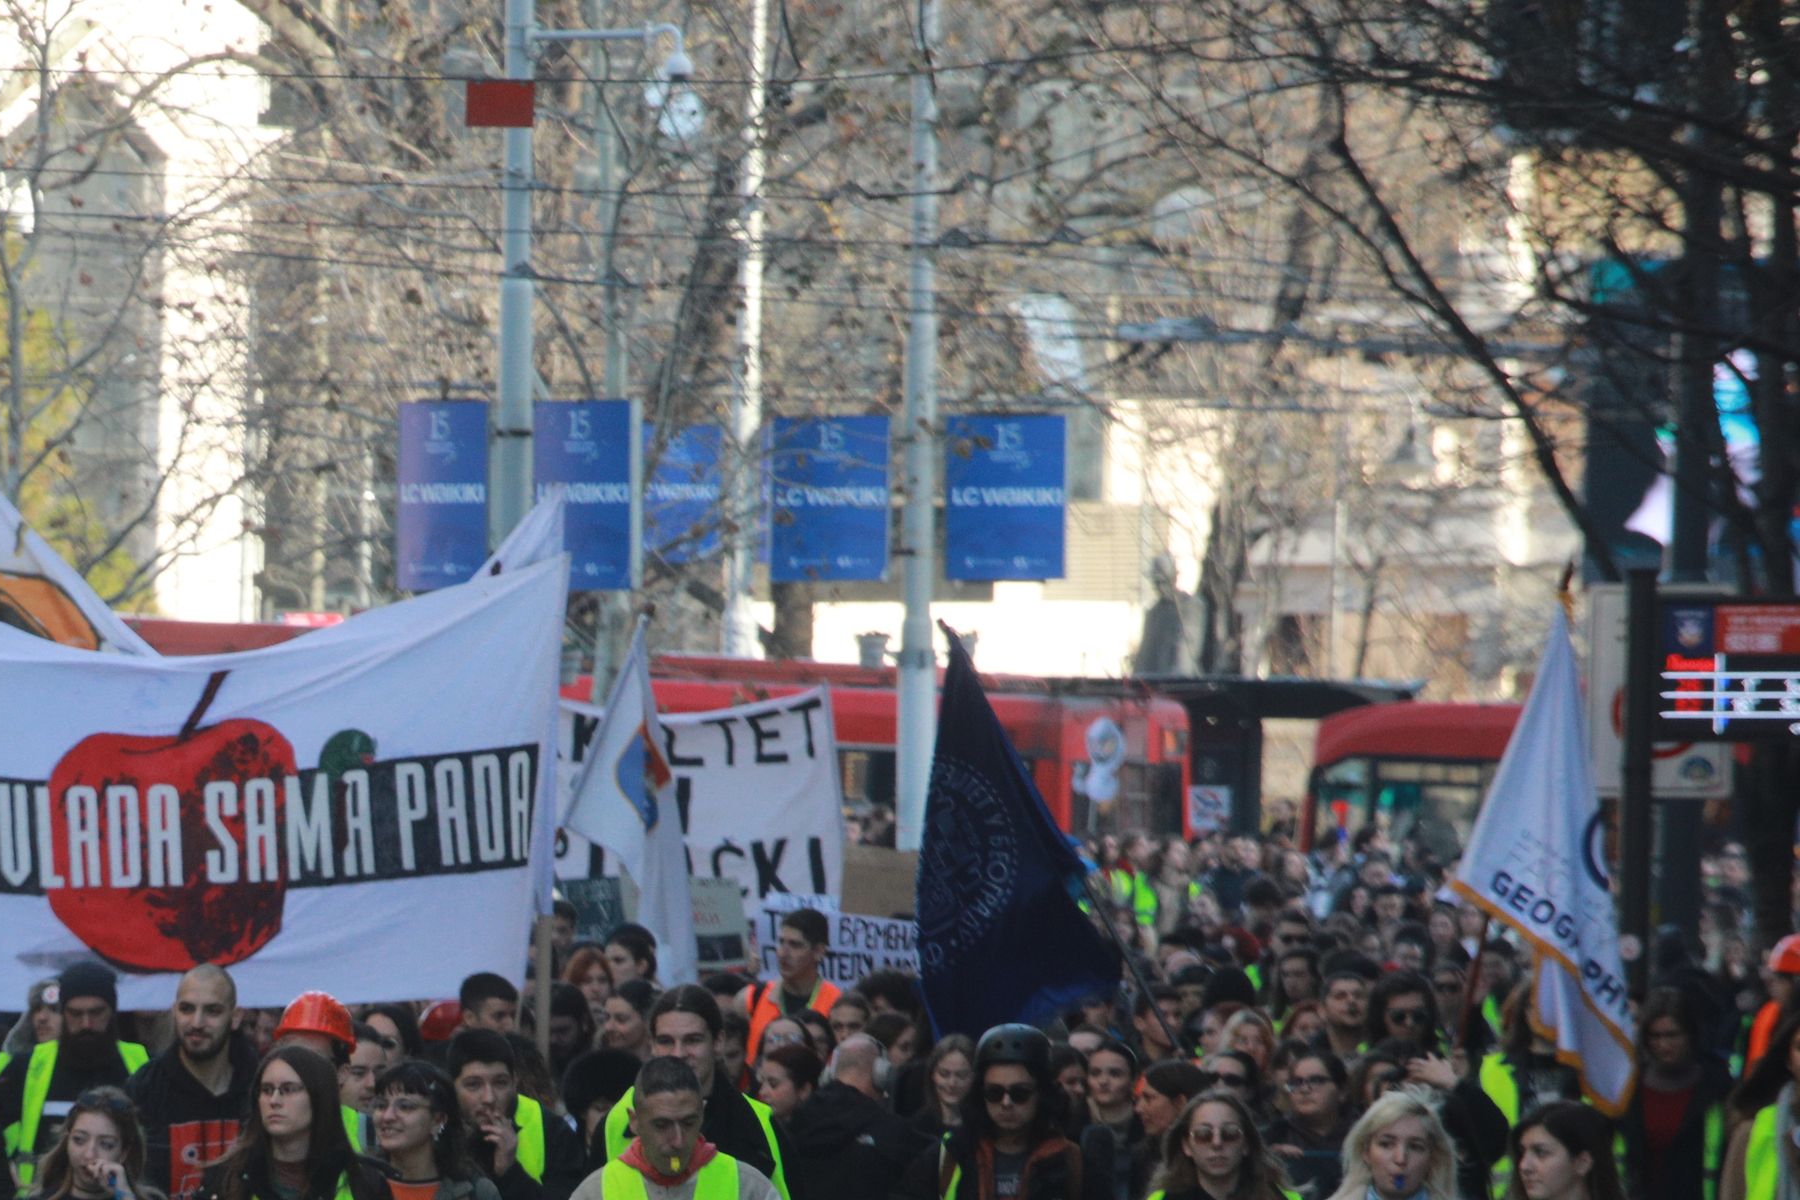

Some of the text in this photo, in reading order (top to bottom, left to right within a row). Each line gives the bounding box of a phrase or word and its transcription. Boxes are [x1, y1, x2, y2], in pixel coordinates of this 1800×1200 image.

[951, 487, 981, 507] LC
[206, 768, 377, 884] SAMA
[398, 750, 531, 873] PADA
